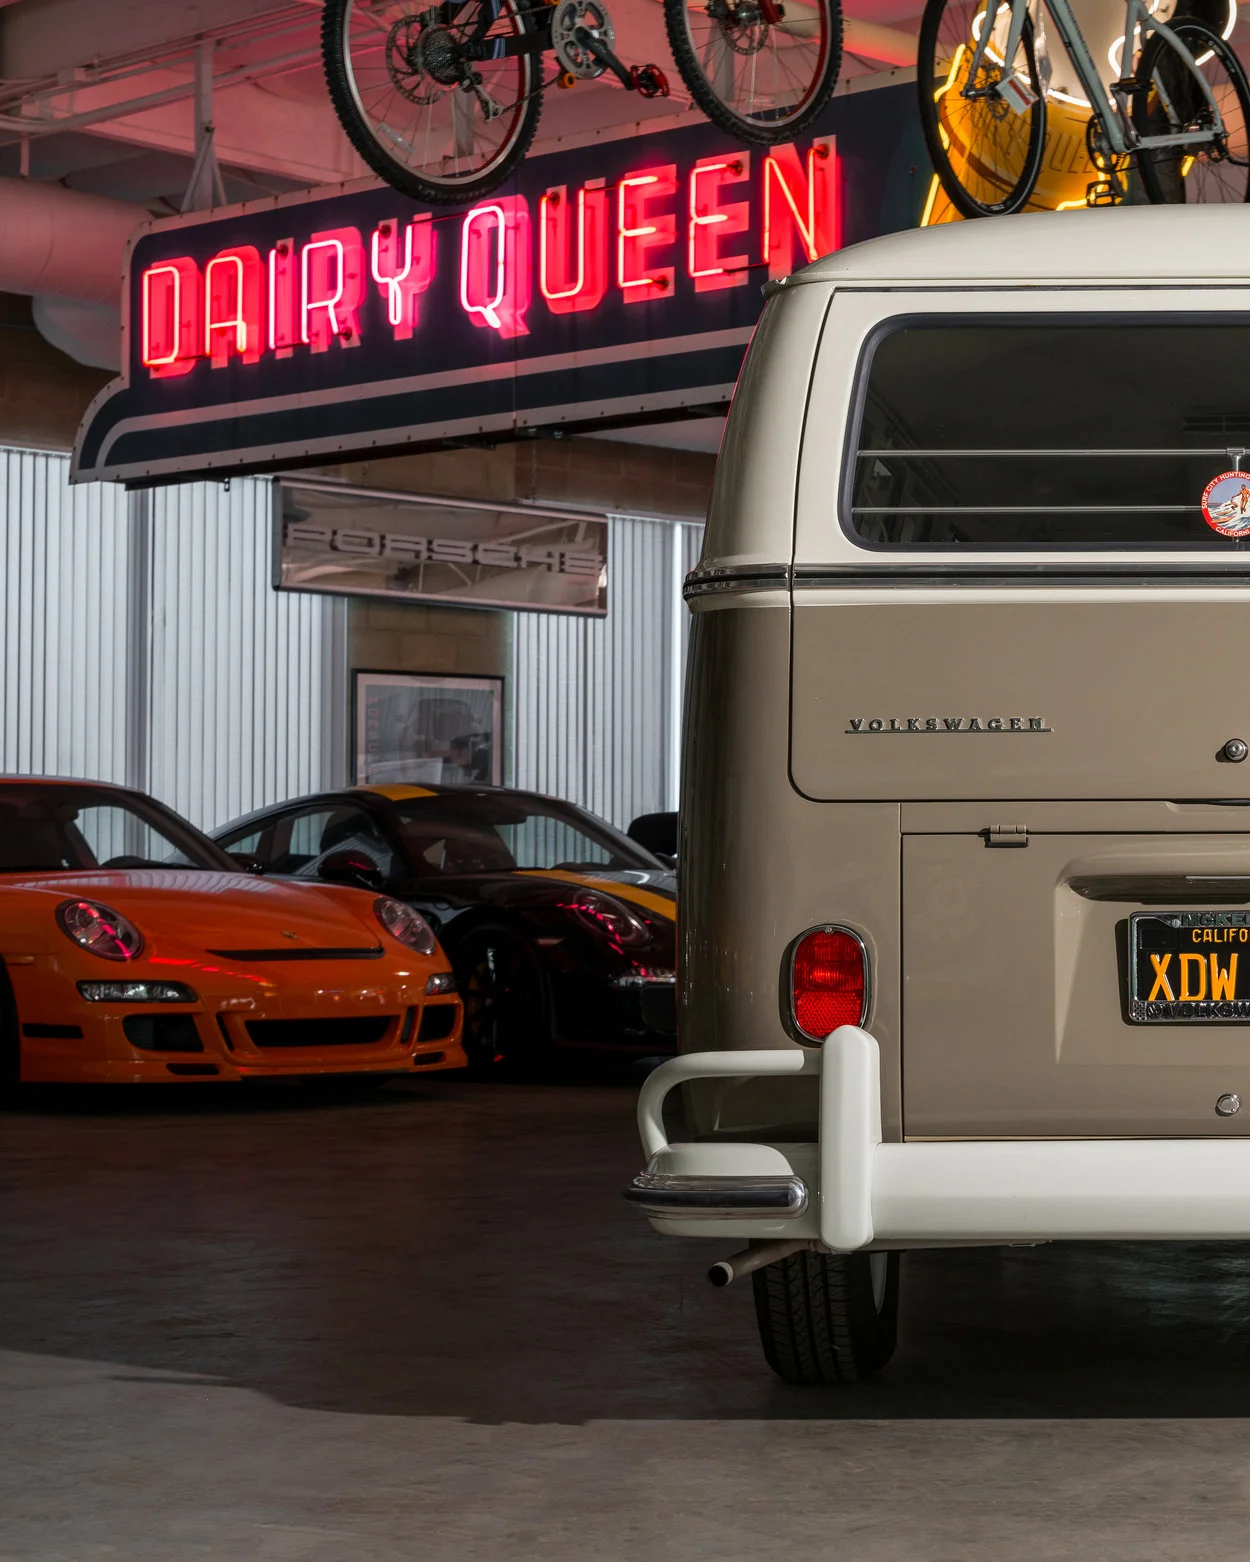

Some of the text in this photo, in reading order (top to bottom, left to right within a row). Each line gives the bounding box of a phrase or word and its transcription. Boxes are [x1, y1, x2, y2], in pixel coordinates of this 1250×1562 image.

[143, 134, 841, 379] DAIRY QUEEN
[1201, 492, 1209, 509] SURF
[1206, 478, 1220, 492] CITY
[283, 522, 603, 577] PORSCHE
[849, 717, 1044, 731] VOLKSWAGEN
[1148, 952, 1239, 1002] XDW
